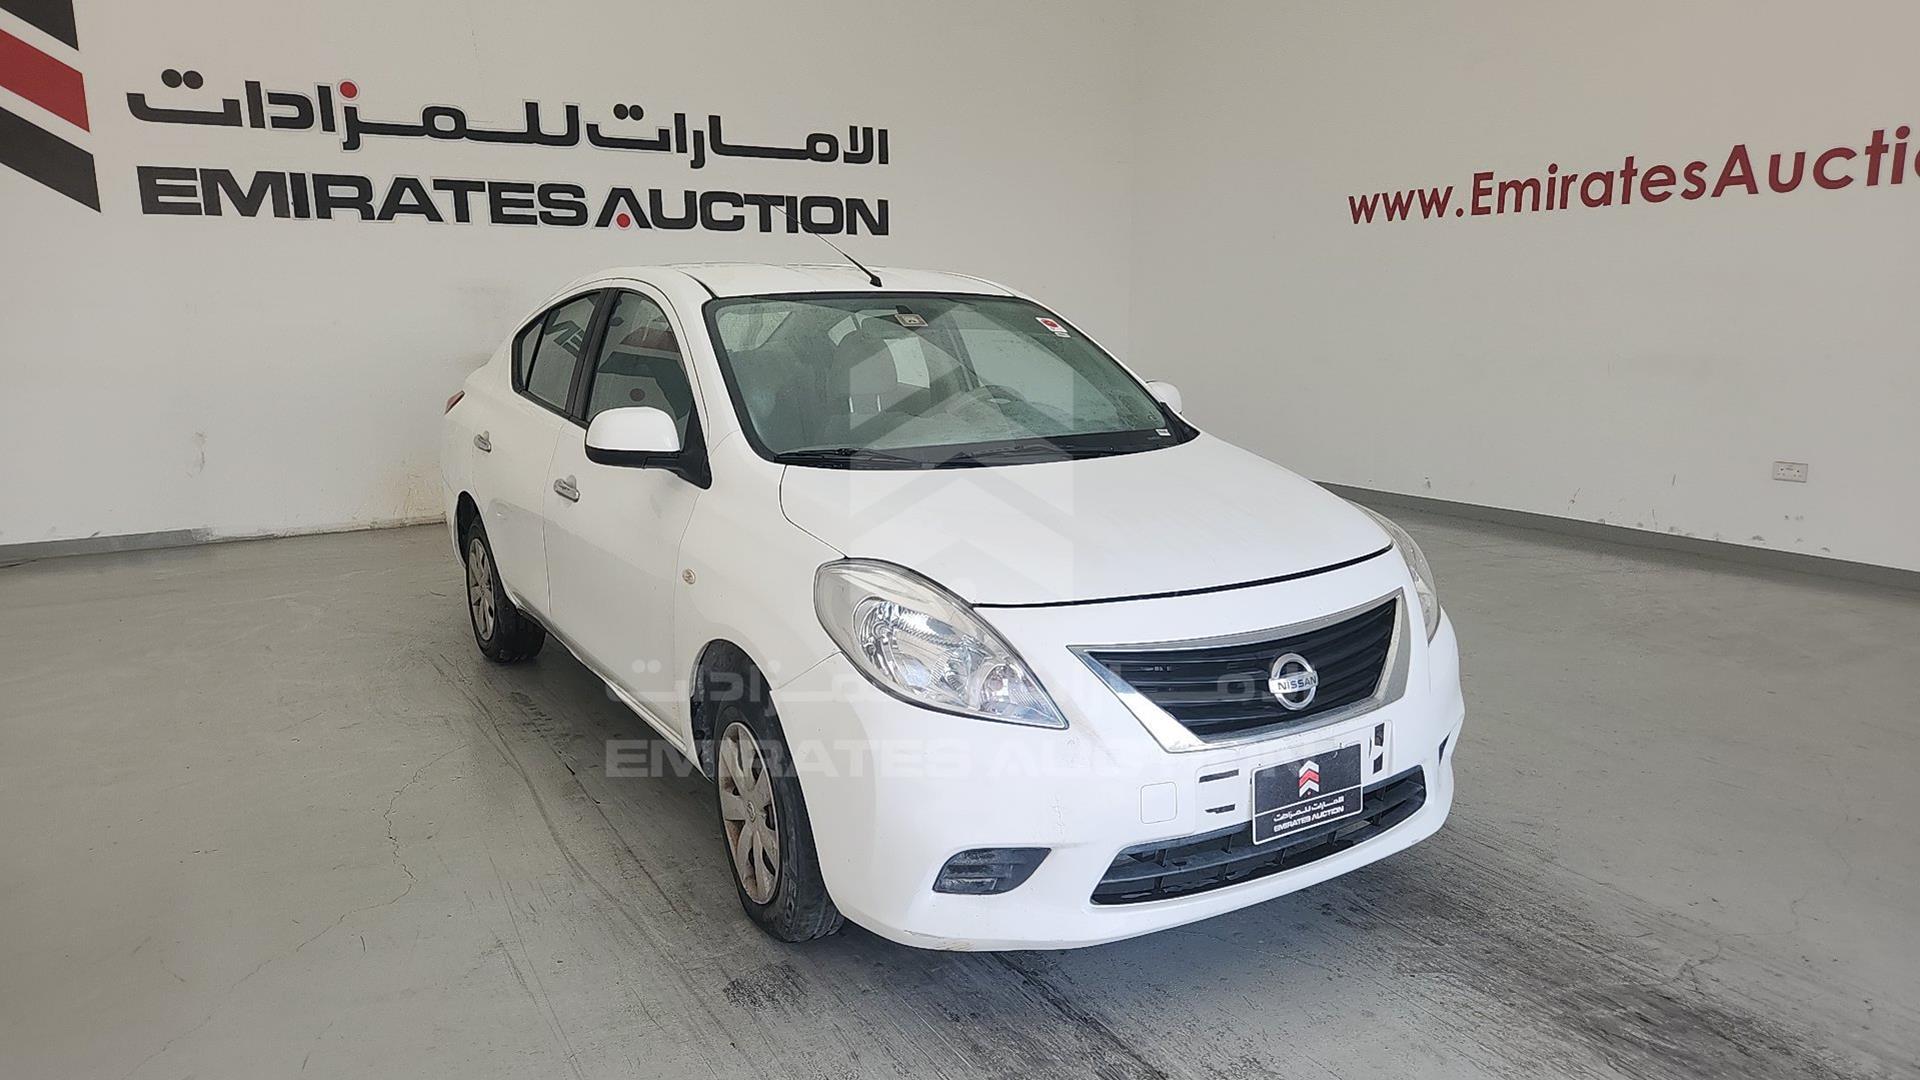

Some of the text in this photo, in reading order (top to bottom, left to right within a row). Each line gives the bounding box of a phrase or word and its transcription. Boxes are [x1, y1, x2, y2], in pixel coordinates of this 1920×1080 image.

[126, 69, 580, 151] للمزادات
[137, 166, 889, 236] EMIRATES AUCTION
[1349, 125, 1920, 225] www.EmiratesAucti
[1277, 675, 1317, 691] NISSAN
[1311, 805, 1345, 821] AUCTION
